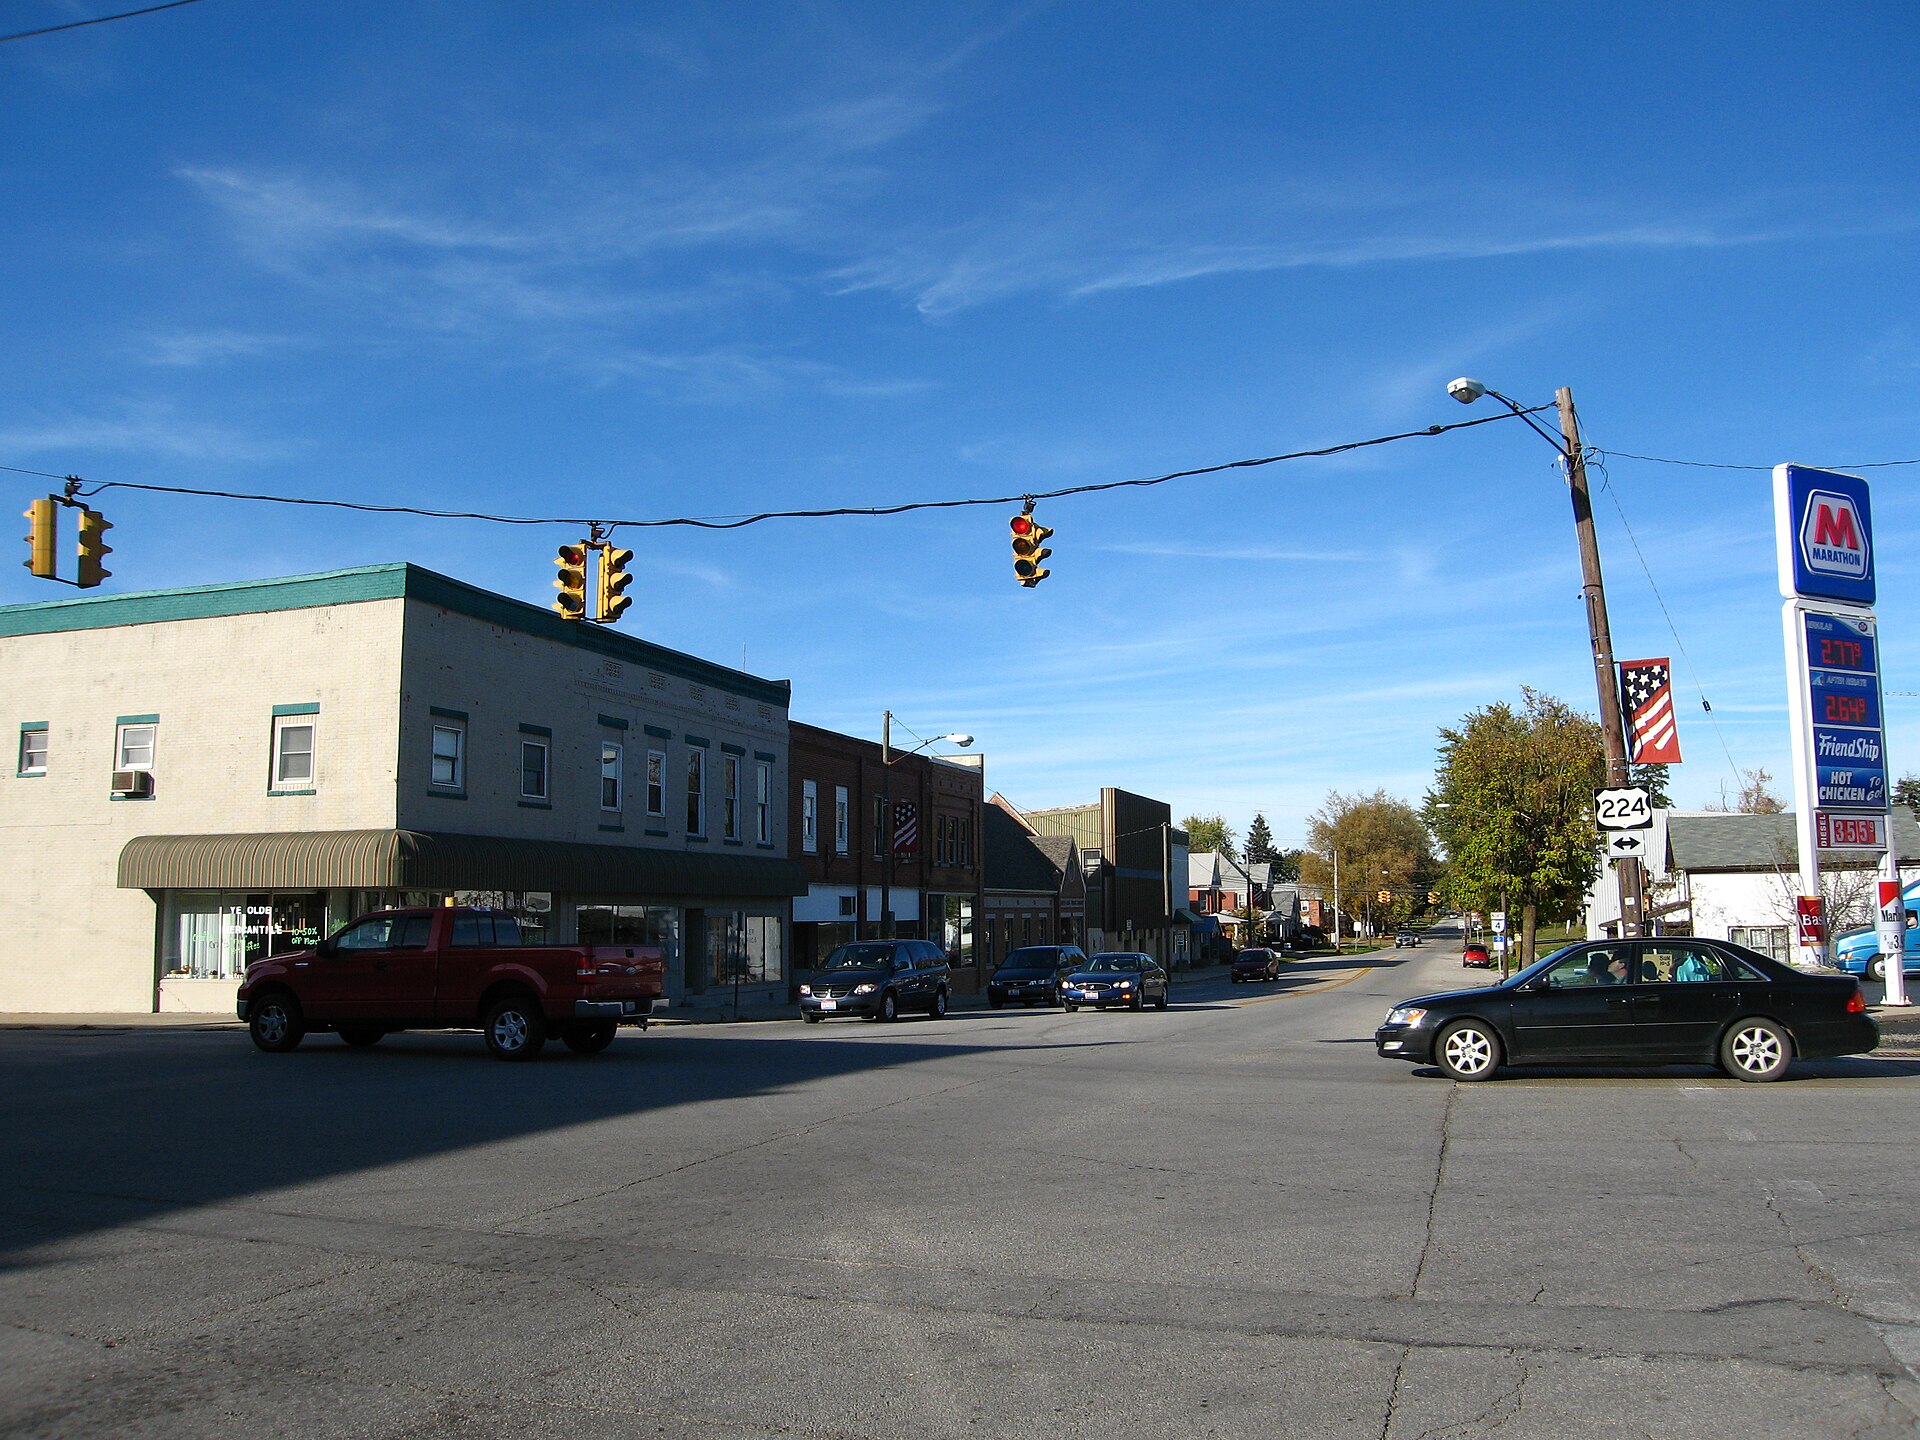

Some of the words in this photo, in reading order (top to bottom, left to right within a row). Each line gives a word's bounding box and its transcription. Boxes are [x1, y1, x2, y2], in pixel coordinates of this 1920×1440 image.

[1812, 547, 1861, 567] MARATHON
[1818, 732, 1879, 762] FriendShip
[1830, 771, 1853, 785] HOT
[1869, 776, 1881, 787] TO
[1819, 785, 1866, 801] CHICKEN
[1601, 797, 1646, 818] 224
[1819, 814, 1828, 847] DIESEL
[230, 906, 242, 915] YE
[246, 906, 273, 915] OLDE
